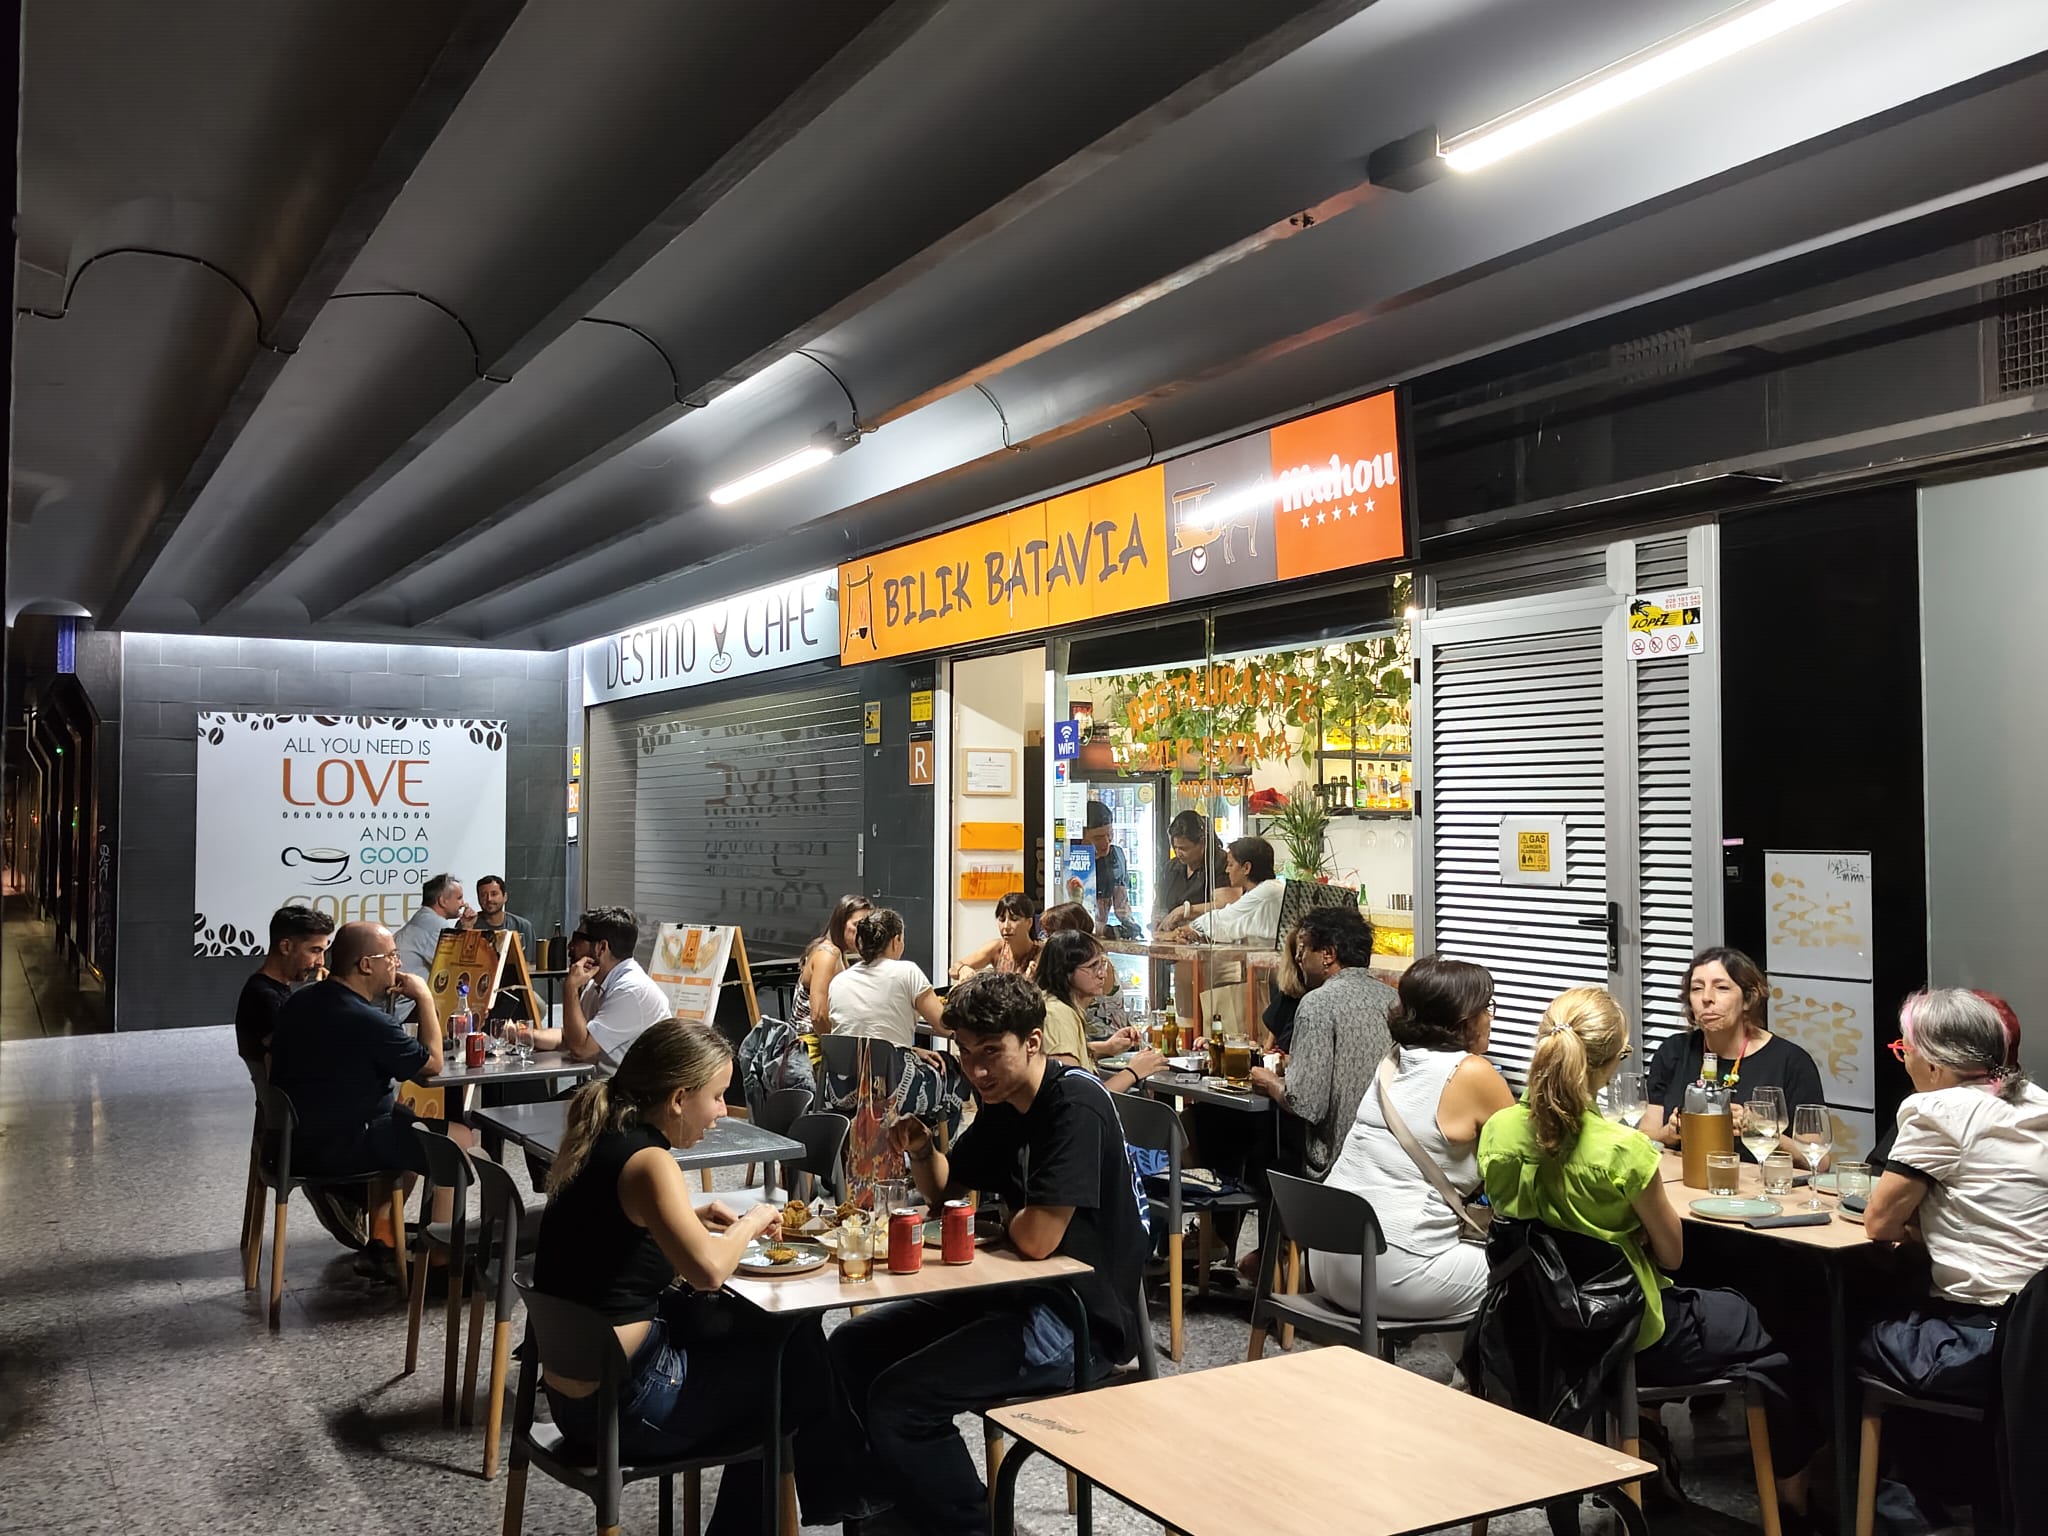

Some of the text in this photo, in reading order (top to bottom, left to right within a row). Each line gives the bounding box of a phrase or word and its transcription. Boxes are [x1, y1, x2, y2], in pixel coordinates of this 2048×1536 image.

[884, 513, 1148, 627] BILIK BATAVIA
[606, 618, 696, 690] DESTINO
[1127, 666, 1319, 737] RESTAURANTE
[283, 737, 431, 756] ALL YOU NEED IS
[914, 747, 928, 779] R
[283, 758, 430, 807] LOVE
[360, 826, 429, 841] AND A
[1529, 835, 1546, 843] GAS
[360, 847, 429, 864] GOOD
[360, 869, 429, 885] CUP OF
